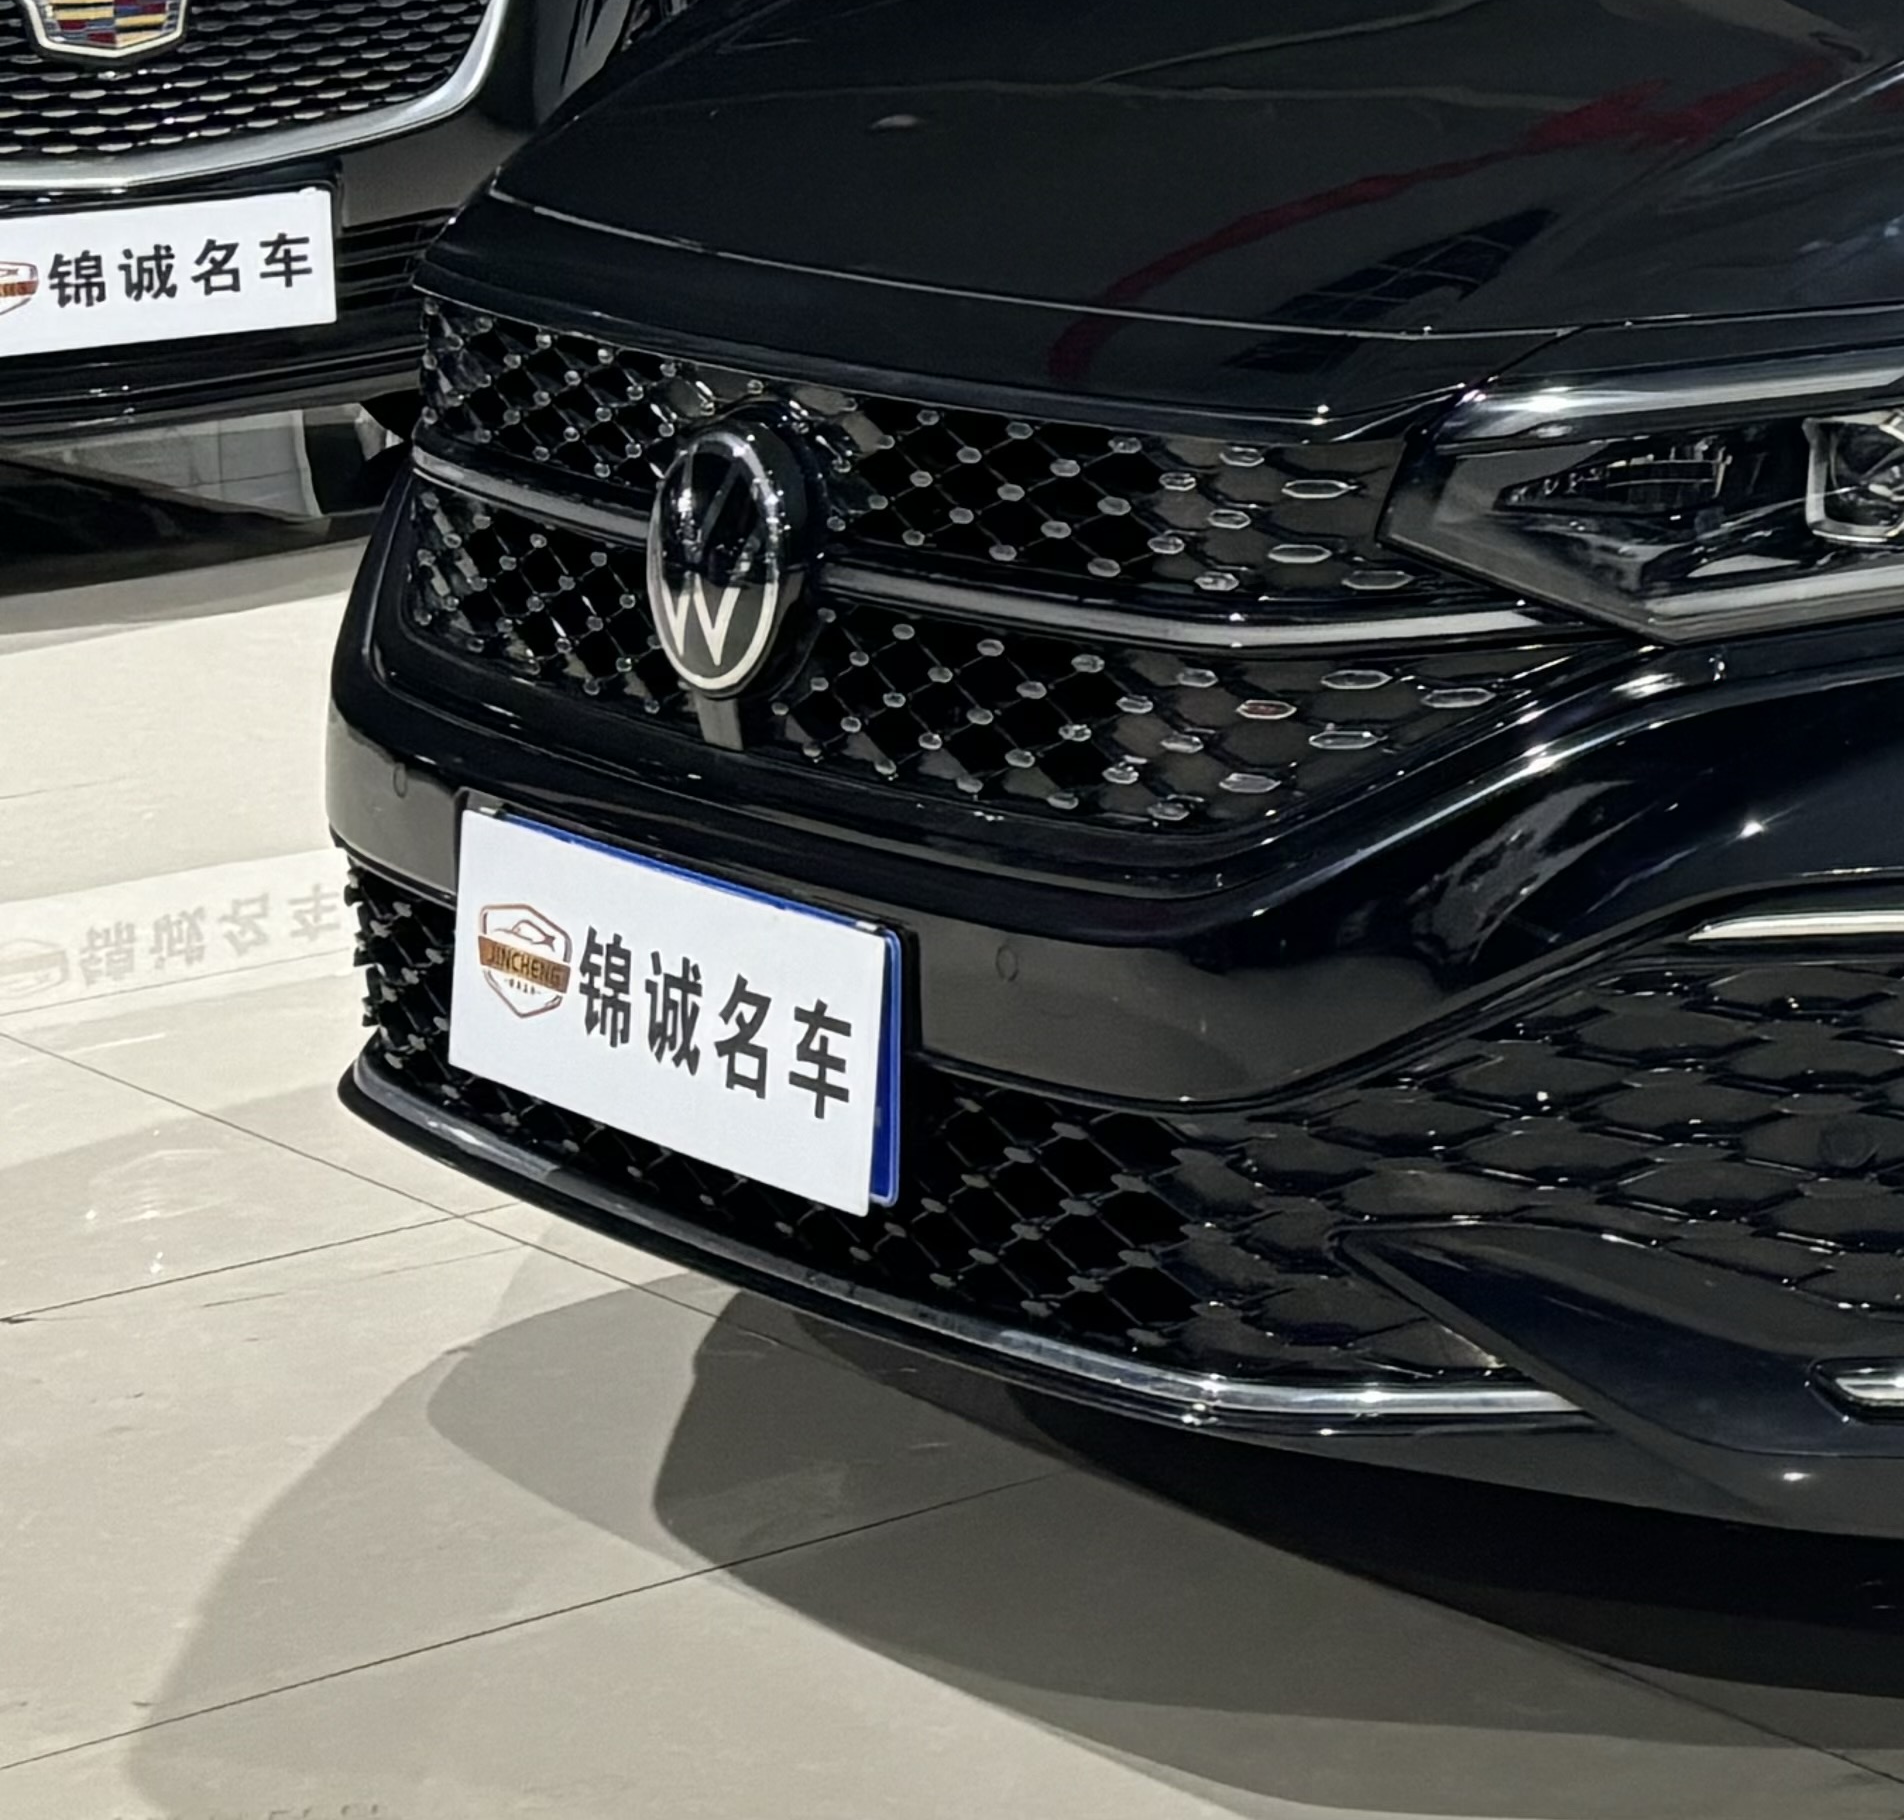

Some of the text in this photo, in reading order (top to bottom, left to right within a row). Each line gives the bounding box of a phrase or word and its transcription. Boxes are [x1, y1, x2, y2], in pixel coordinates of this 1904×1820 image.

[48, 232, 313, 308] 锦诚名车
[578, 926, 853, 1120] 锦诚名车
